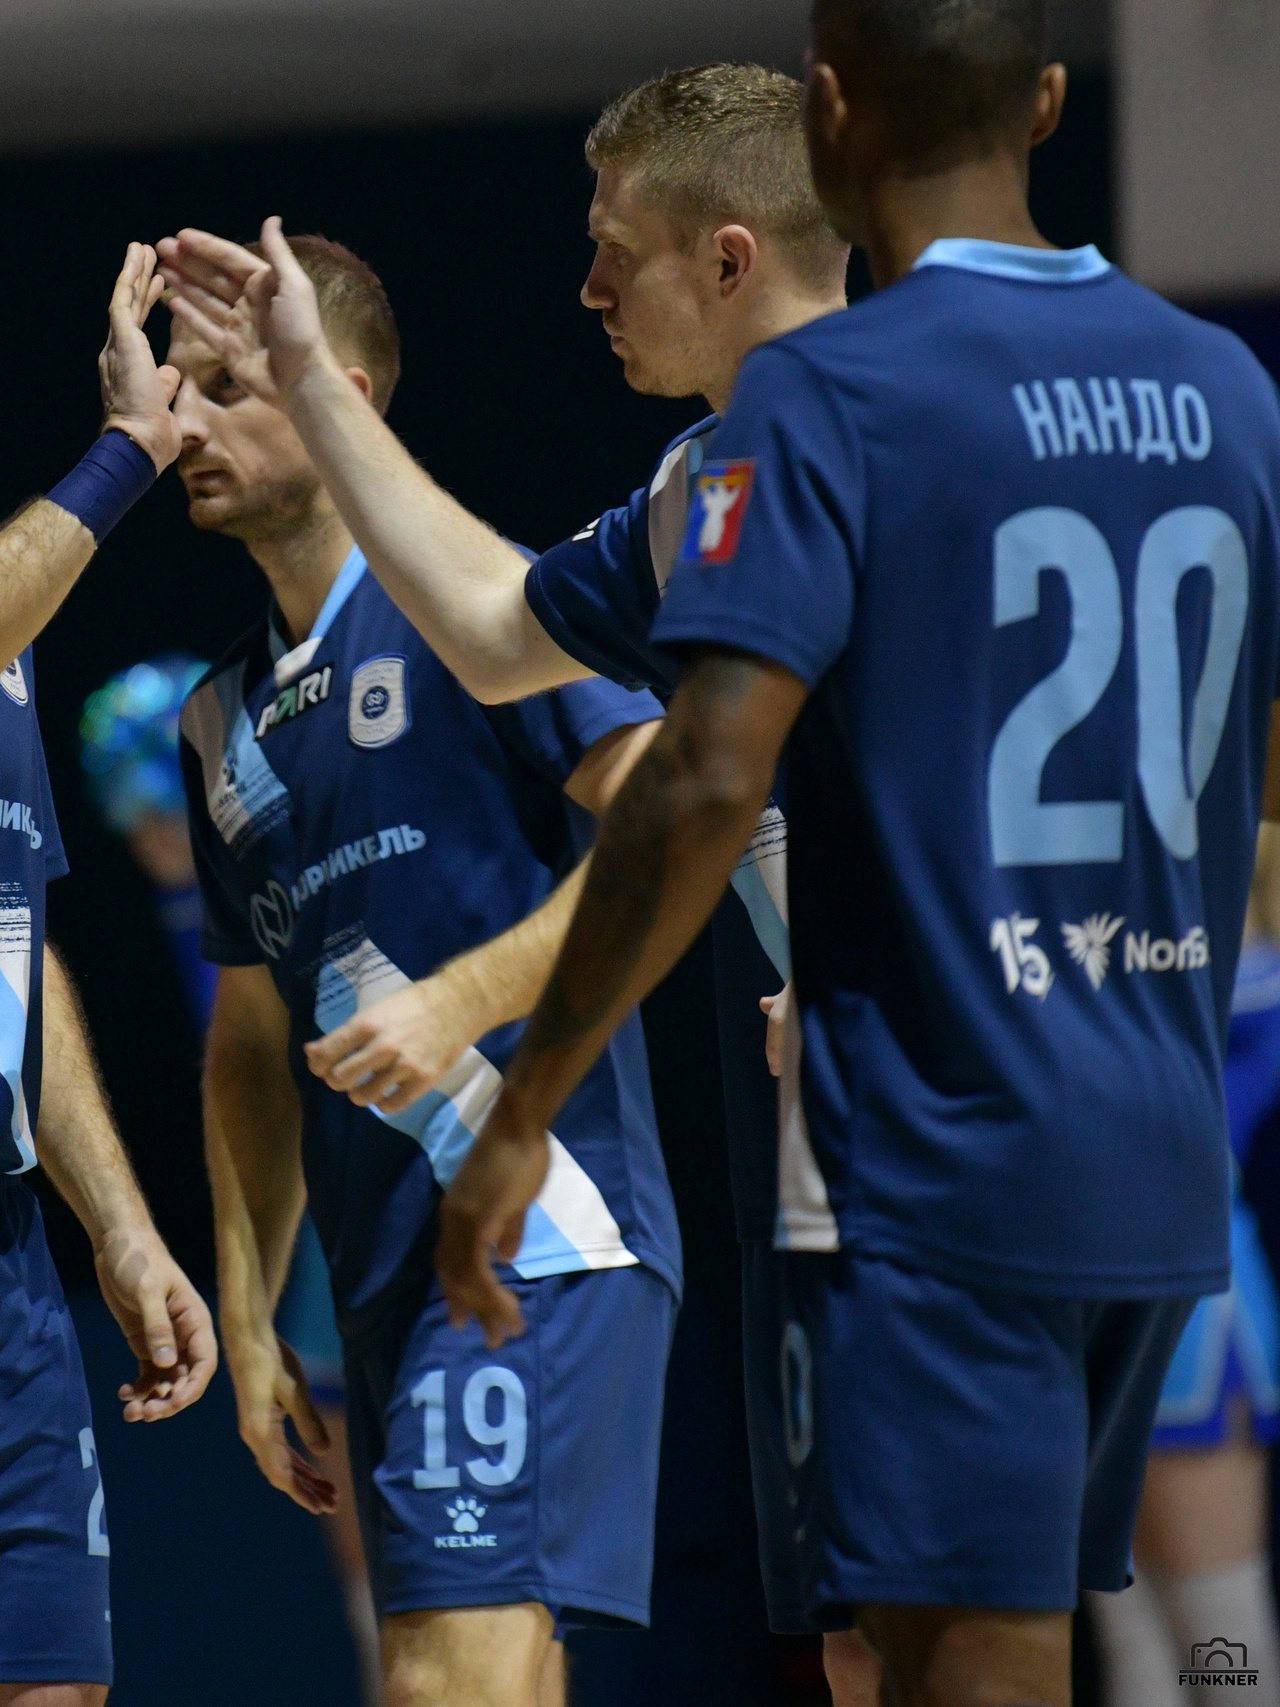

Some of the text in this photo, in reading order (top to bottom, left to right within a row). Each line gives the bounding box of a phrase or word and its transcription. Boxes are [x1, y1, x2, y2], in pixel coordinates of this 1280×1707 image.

[1013, 377, 1212, 465] НАНДО
[987, 505, 1250, 868] 20
[411, 1366, 528, 1490] 19
[434, 1534, 498, 1549] KELME
